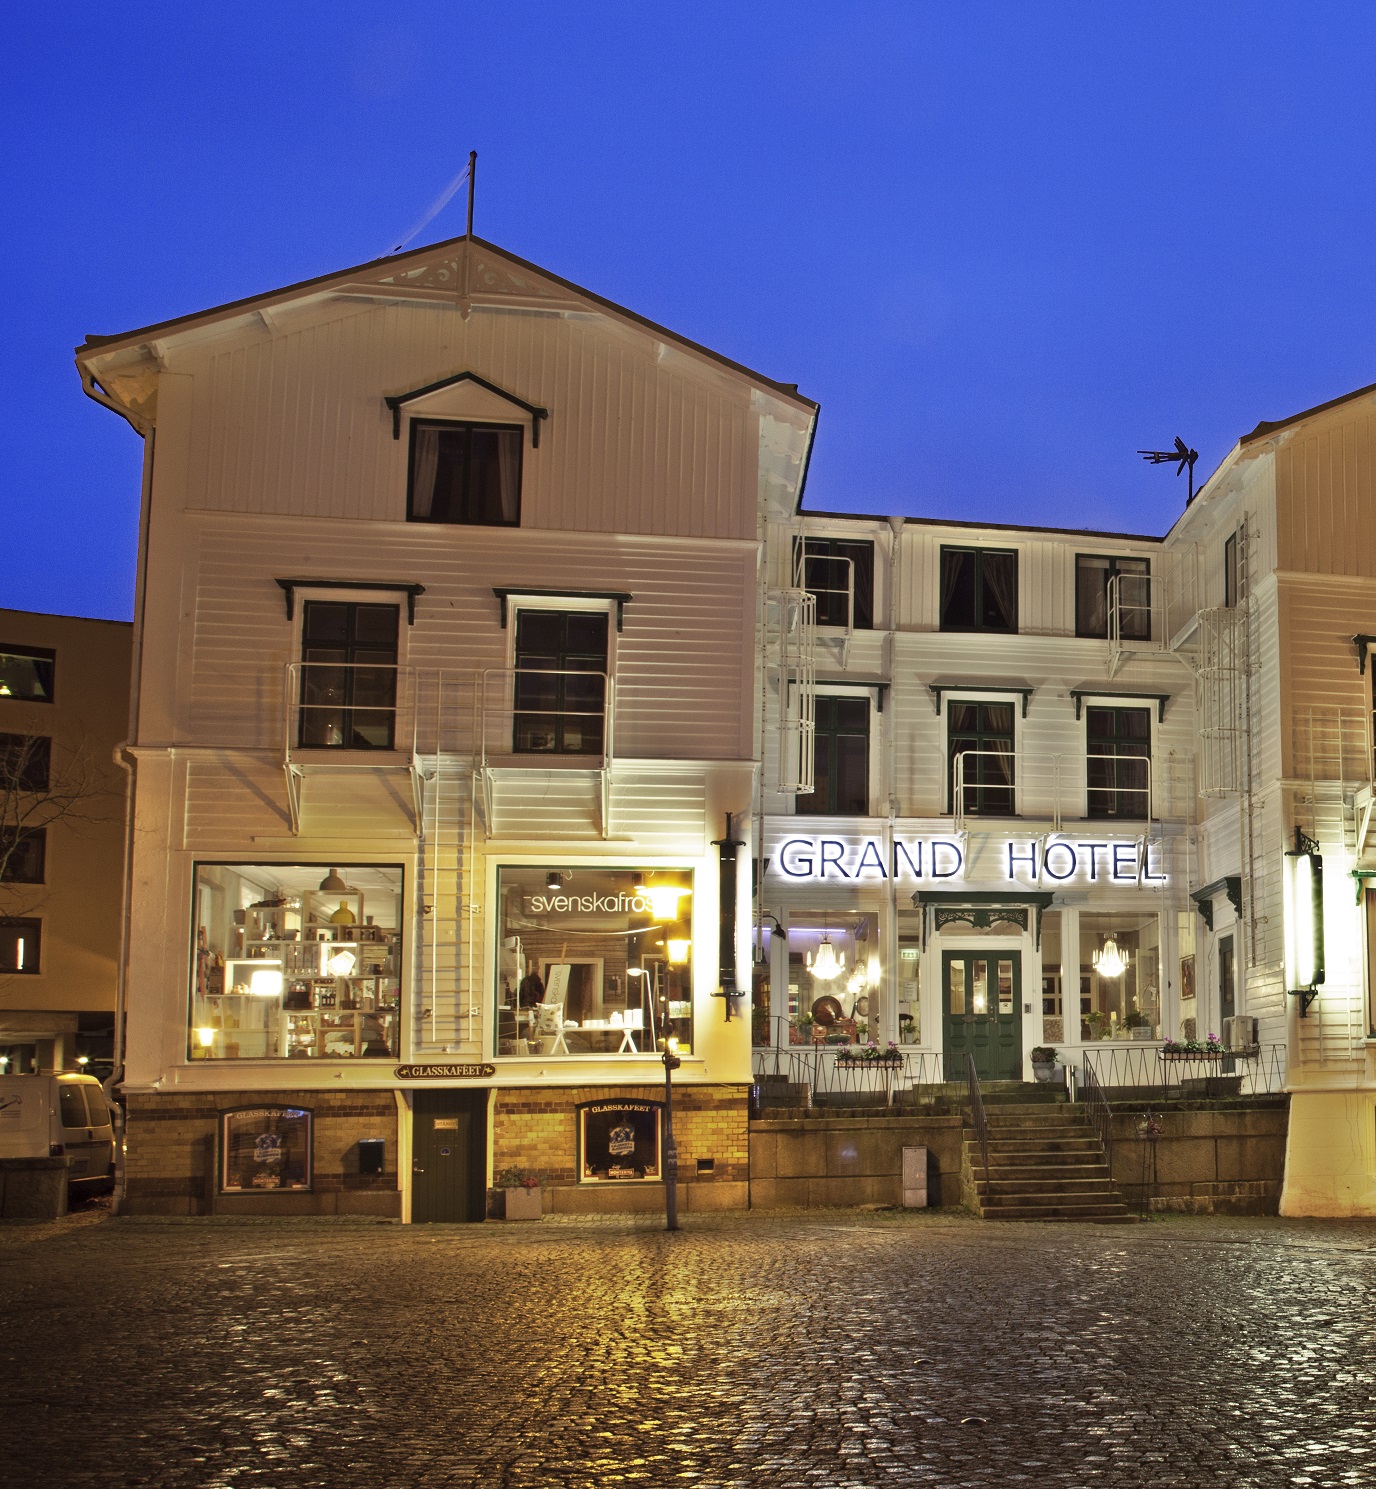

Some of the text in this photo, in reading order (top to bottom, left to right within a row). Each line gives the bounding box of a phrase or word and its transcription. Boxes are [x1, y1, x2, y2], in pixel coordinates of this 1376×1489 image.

[779, 839, 1167, 880] GRAND HOTEL
[531, 892, 655, 912] svenskafros
